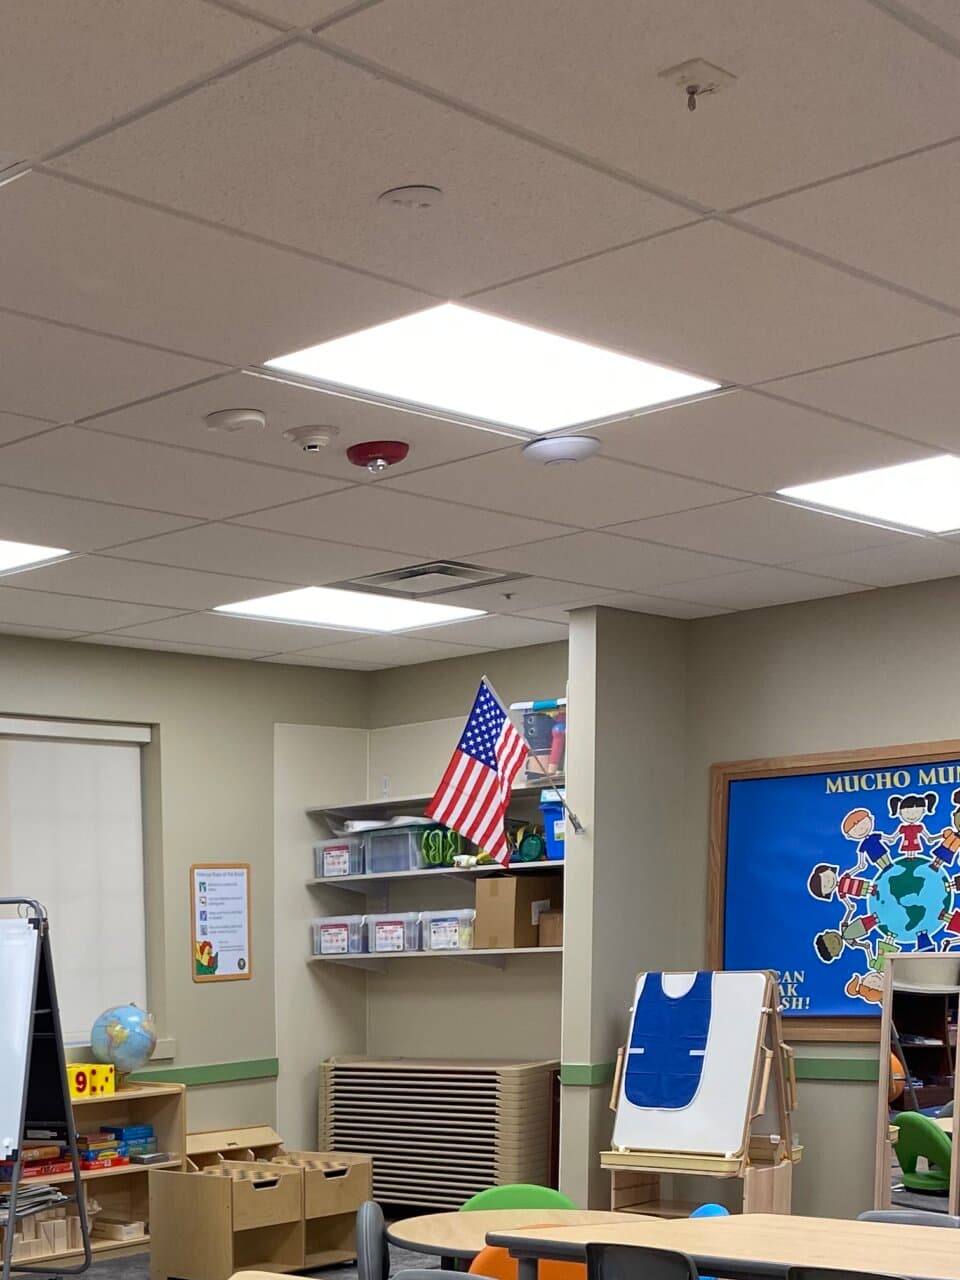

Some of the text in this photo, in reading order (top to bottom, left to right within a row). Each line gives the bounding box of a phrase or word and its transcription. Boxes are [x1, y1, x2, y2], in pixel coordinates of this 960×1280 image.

[824, 766, 960, 794] MUCHO MU
[75, 1071, 87, 1093] 9
